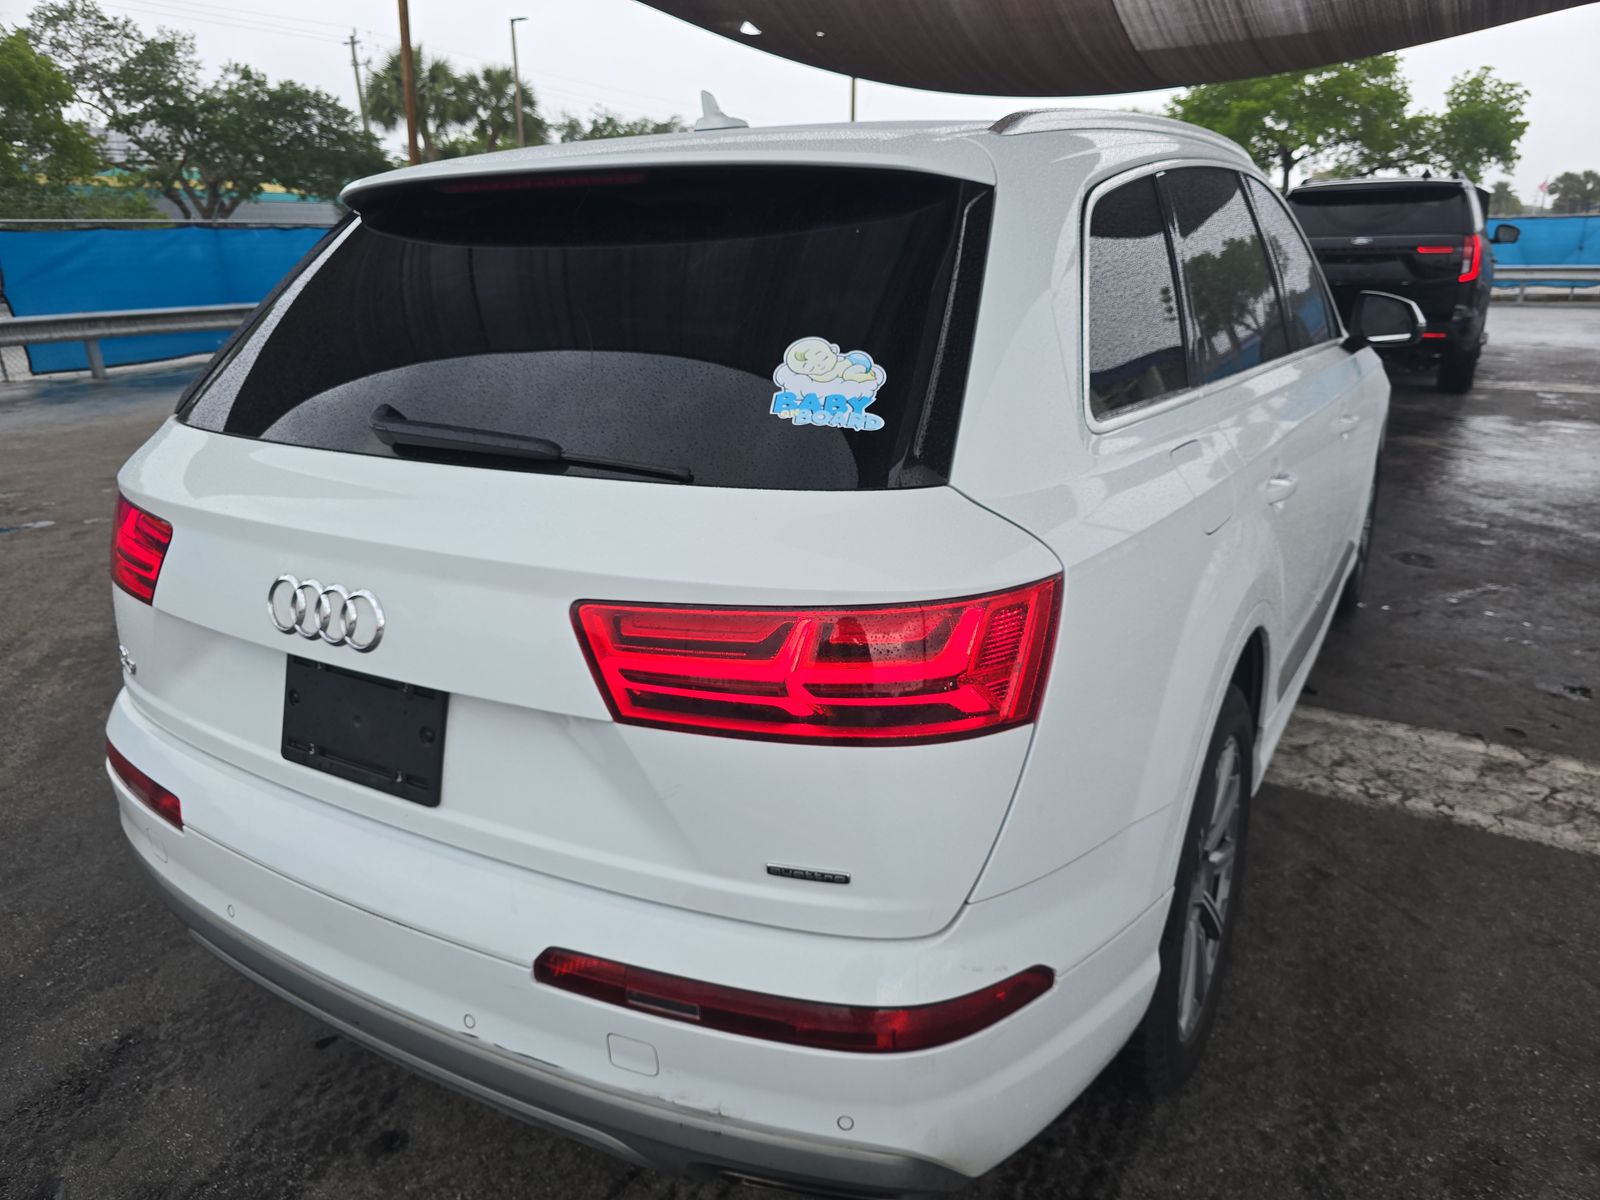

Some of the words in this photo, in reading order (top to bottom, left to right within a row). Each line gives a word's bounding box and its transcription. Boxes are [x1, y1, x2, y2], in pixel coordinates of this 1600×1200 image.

[773, 391, 872, 416] BABY
[796, 410, 882, 430] BOARD
[768, 865, 847, 883] quattro
